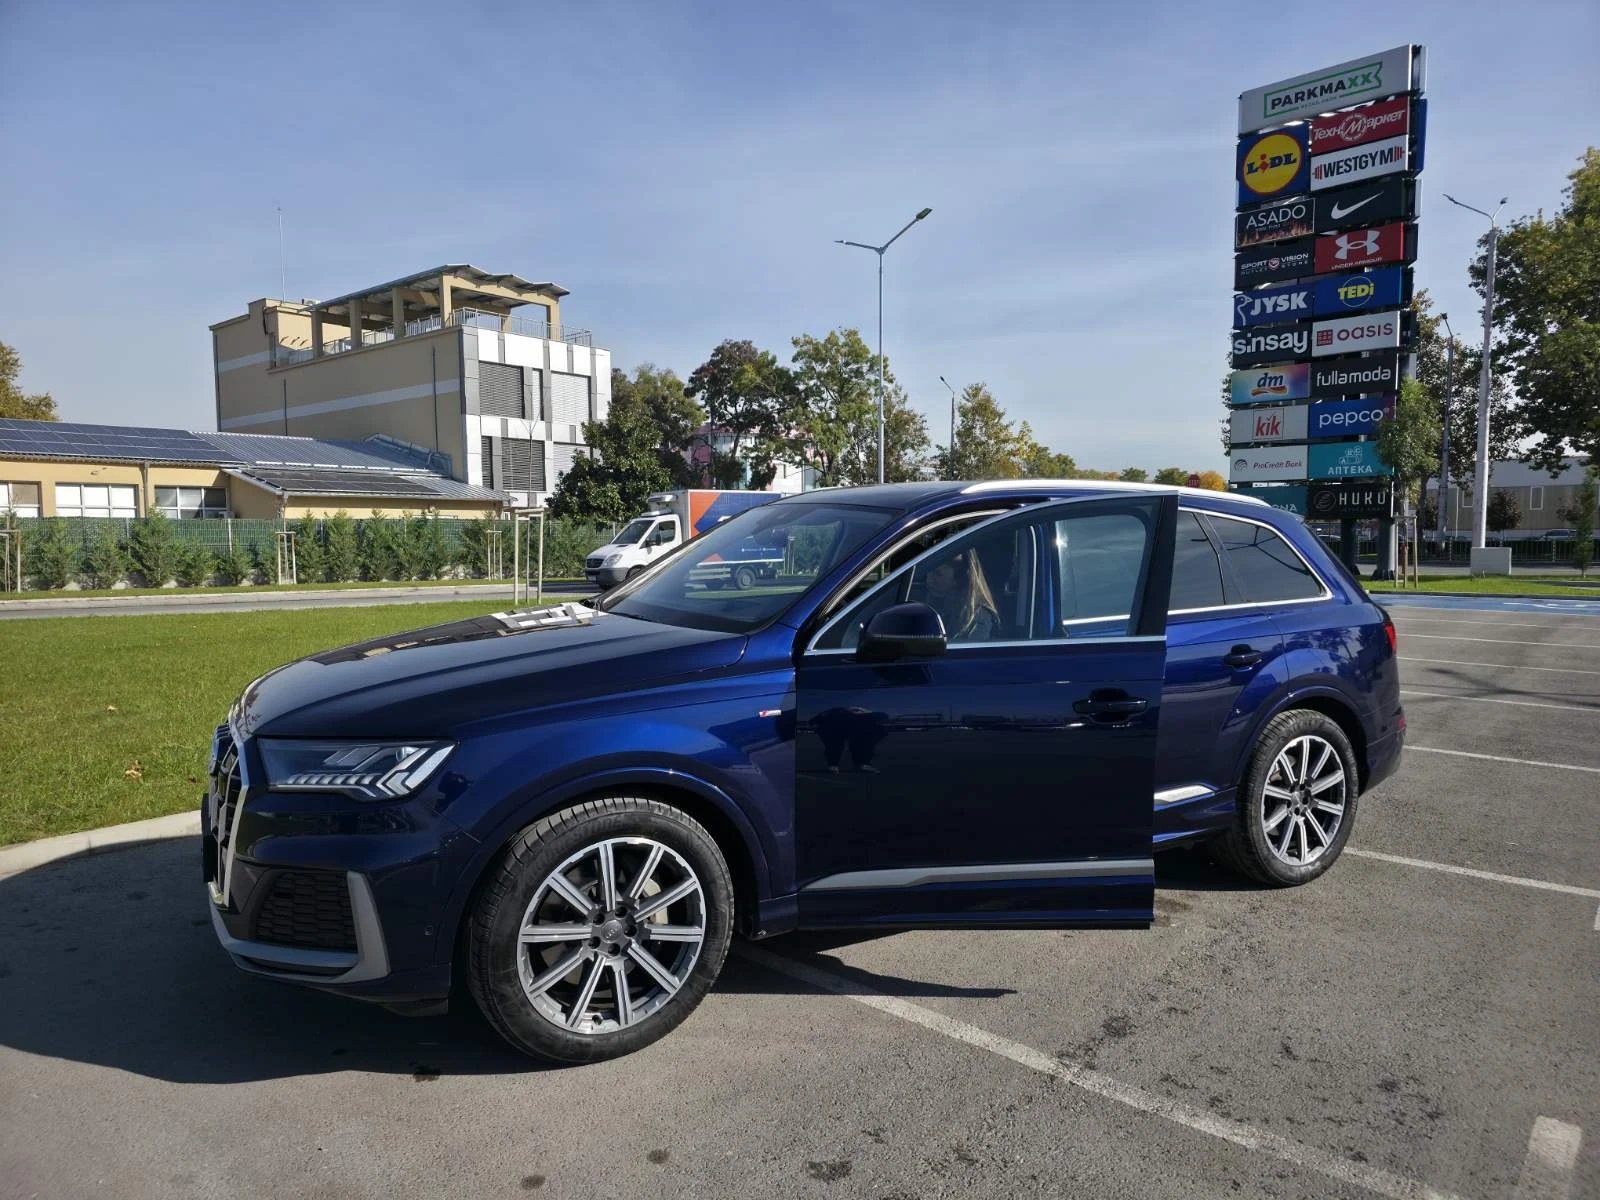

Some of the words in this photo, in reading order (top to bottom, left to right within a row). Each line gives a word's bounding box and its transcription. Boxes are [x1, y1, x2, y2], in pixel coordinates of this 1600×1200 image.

[1271, 71, 1373, 110] PARKMAXX
[1323, 147, 1394, 178] WESTGYM
[1246, 204, 1306, 230] ASADO
[1241, 260, 1268, 270] SPORT
[1281, 253, 1309, 263] VISION
[1250, 291, 1309, 316] JYSK
[1337, 322, 1394, 341] oasis
[1233, 331, 1309, 355] sinsay
[1257, 372, 1284, 388] dm
[1319, 409, 1384, 428] pepco
[1327, 464, 1373, 476] АПТЕКА
